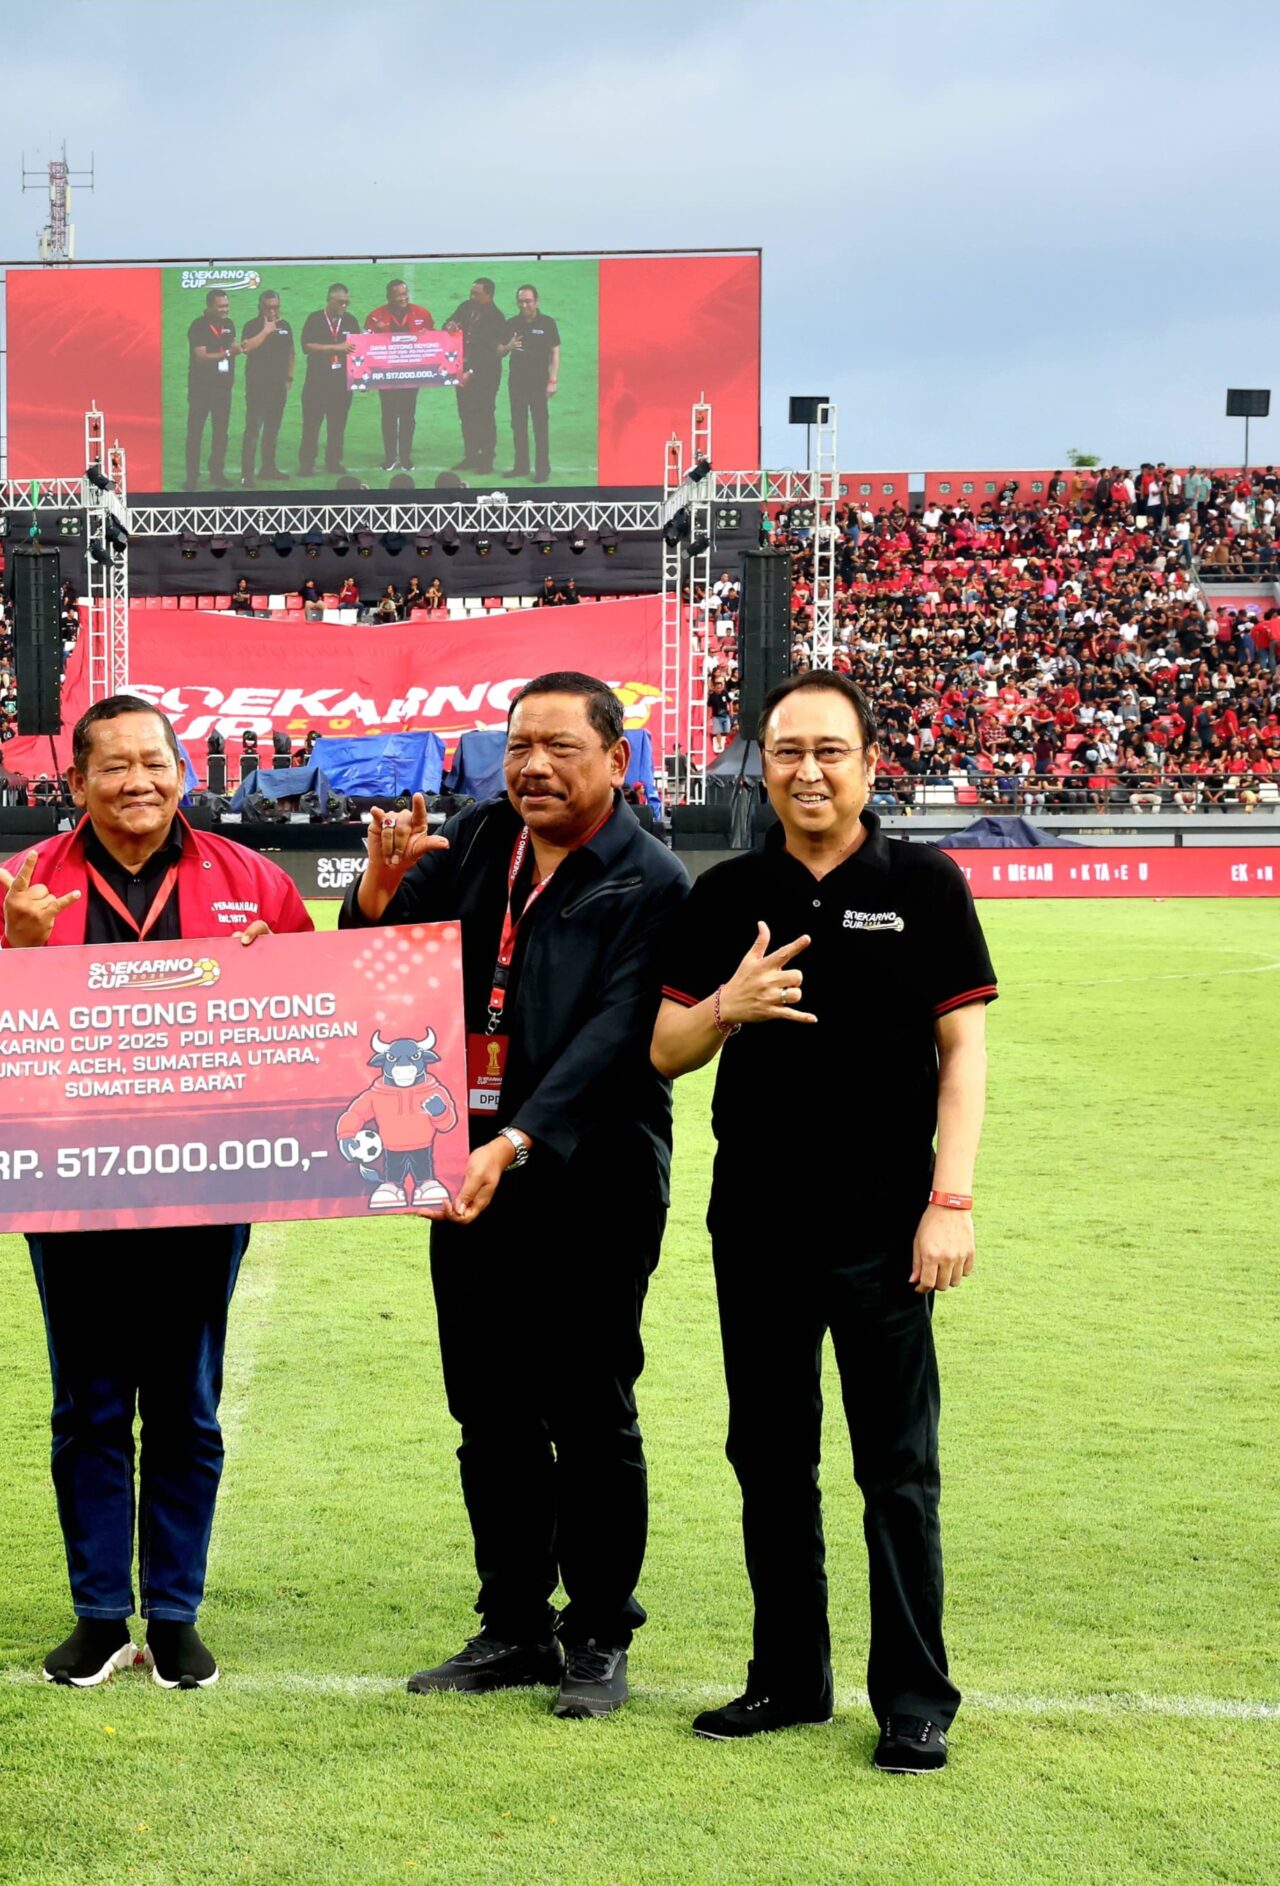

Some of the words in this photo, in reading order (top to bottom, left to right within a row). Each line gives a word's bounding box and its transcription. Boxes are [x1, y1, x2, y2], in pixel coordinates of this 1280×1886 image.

[182, 271, 244, 280] SOEKARNO
[182, 280, 206, 289] CUP
[511, 841, 526, 880] SOEKARNO
[317, 872, 354, 888] CUP
[842, 919, 863, 929] CUP
[844, 910, 896, 921] SOEKARNO
[89, 958, 193, 976] SOEKARNO
[87, 975, 130, 989] CUP
[69, 1001, 197, 1029] GOTONG
[207, 992, 336, 1023] ROYONG
[71, 1035, 113, 1052] CUP
[118, 1032, 169, 1050] 2025
[180, 1029, 213, 1047] PDI
[220, 1021, 358, 1044] PERJUANGAN
[67, 1057, 127, 1075] ACEH,
[132, 1051, 242, 1072] SUMATERA
[248, 1047, 321, 1066] UTARA,
[65, 1077, 175, 1098] SUMATERA
[180, 1073, 246, 1093] BARAT
[56, 1137, 328, 1178] 517.000.000,-
